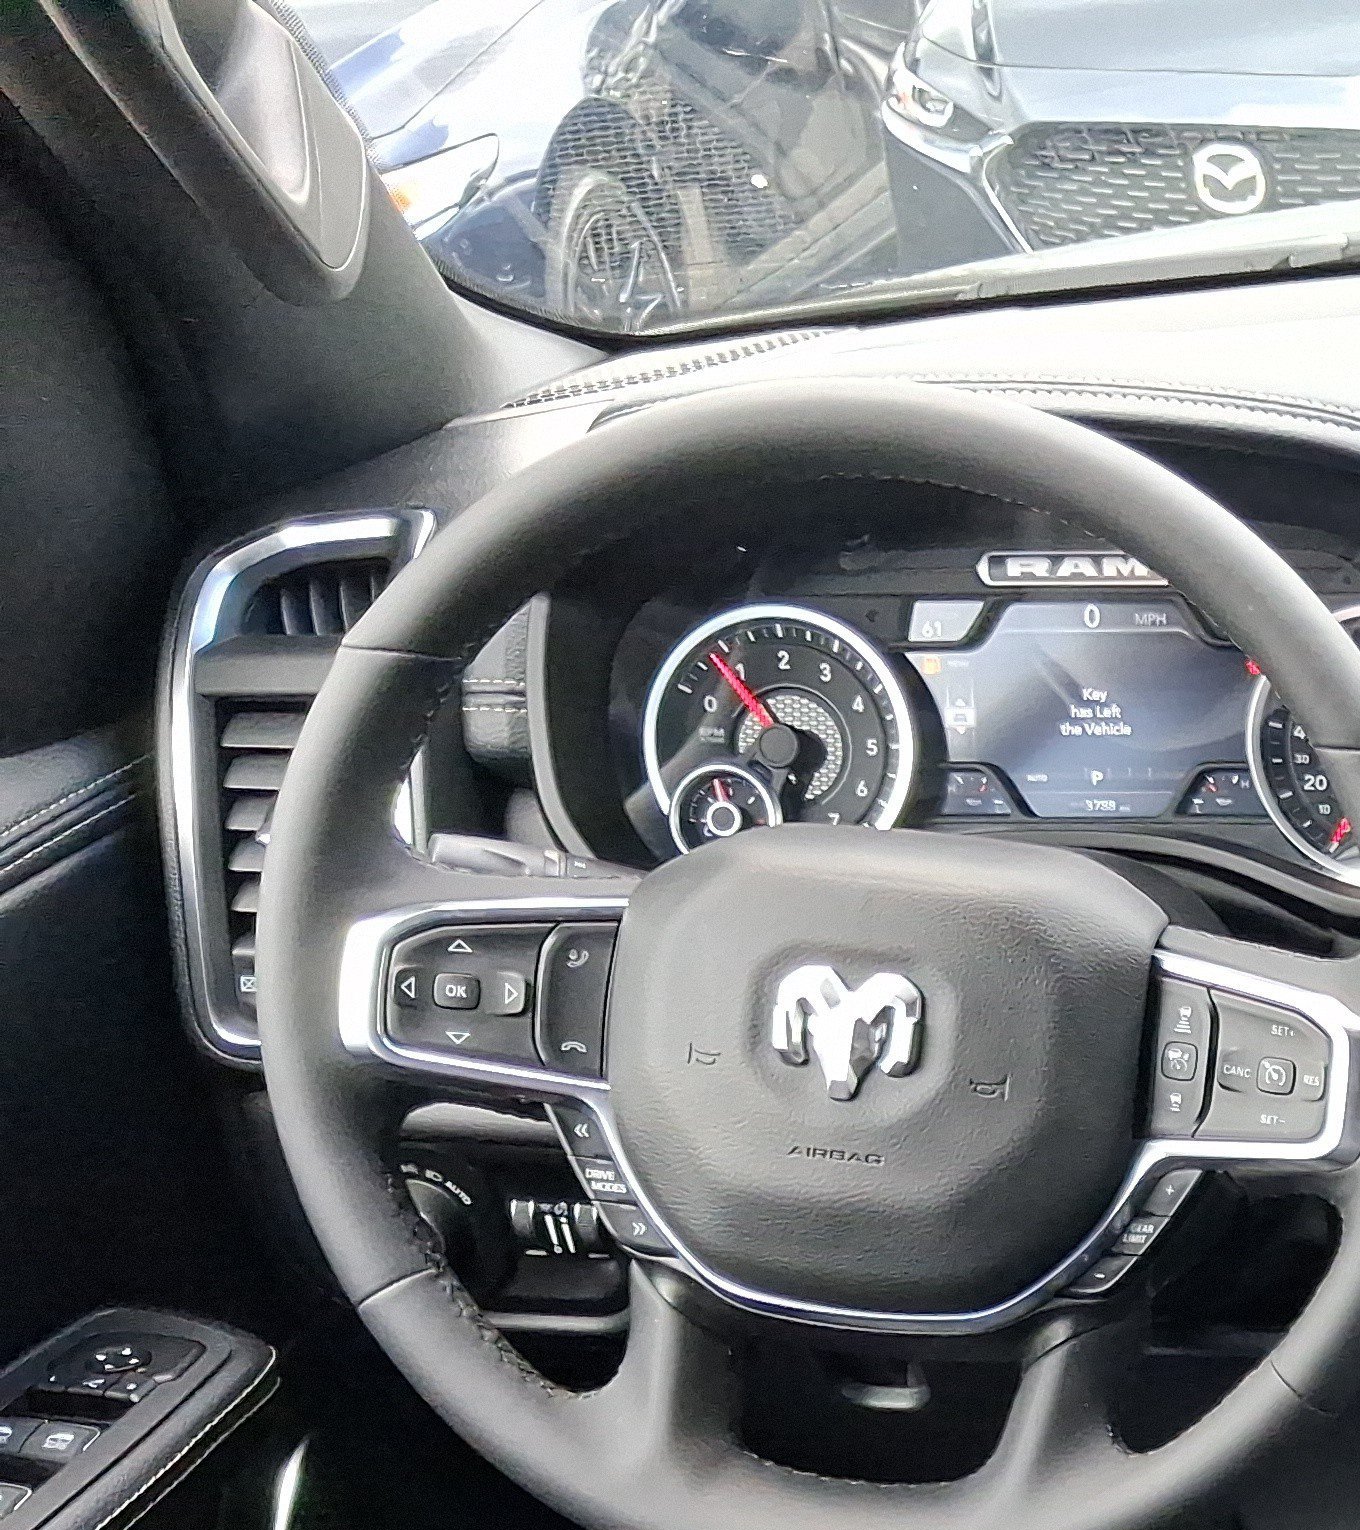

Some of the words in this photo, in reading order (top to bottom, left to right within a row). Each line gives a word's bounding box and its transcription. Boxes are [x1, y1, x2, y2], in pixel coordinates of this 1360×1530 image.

[1006, 557, 1150, 577] RAM
[1083, 603, 1101, 629] 0
[1135, 613, 1167, 627] MPH
[922, 620, 942, 638] 61
[776, 650, 791, 670] 2
[819, 662, 832, 682] 3
[704, 695, 718, 713] 0
[851, 695, 865, 713] 4
[1082, 688, 1108, 703] Key
[1070, 705, 1093, 719] has
[1096, 705, 1121, 719] Left
[1060, 723, 1083, 736] the
[1086, 723, 1132, 736] Vehicle
[865, 739, 878, 757] 5
[1090, 769, 1104, 786] P
[1304, 774, 1328, 791] 20
[856, 779, 868, 797] 6
[1318, 803, 1331, 815] 10
[827, 811, 840, 826] 7
[445, 984, 468, 999] OK
[1223, 1064, 1252, 1078] CANC
[1303, 1075, 1320, 1087] RES
[787, 1145, 885, 1165] AIRBAG
[585, 1168, 615, 1181] DRIVE
[445, 1180, 472, 1205] AUTO
[590, 1181, 628, 1193] MODES
